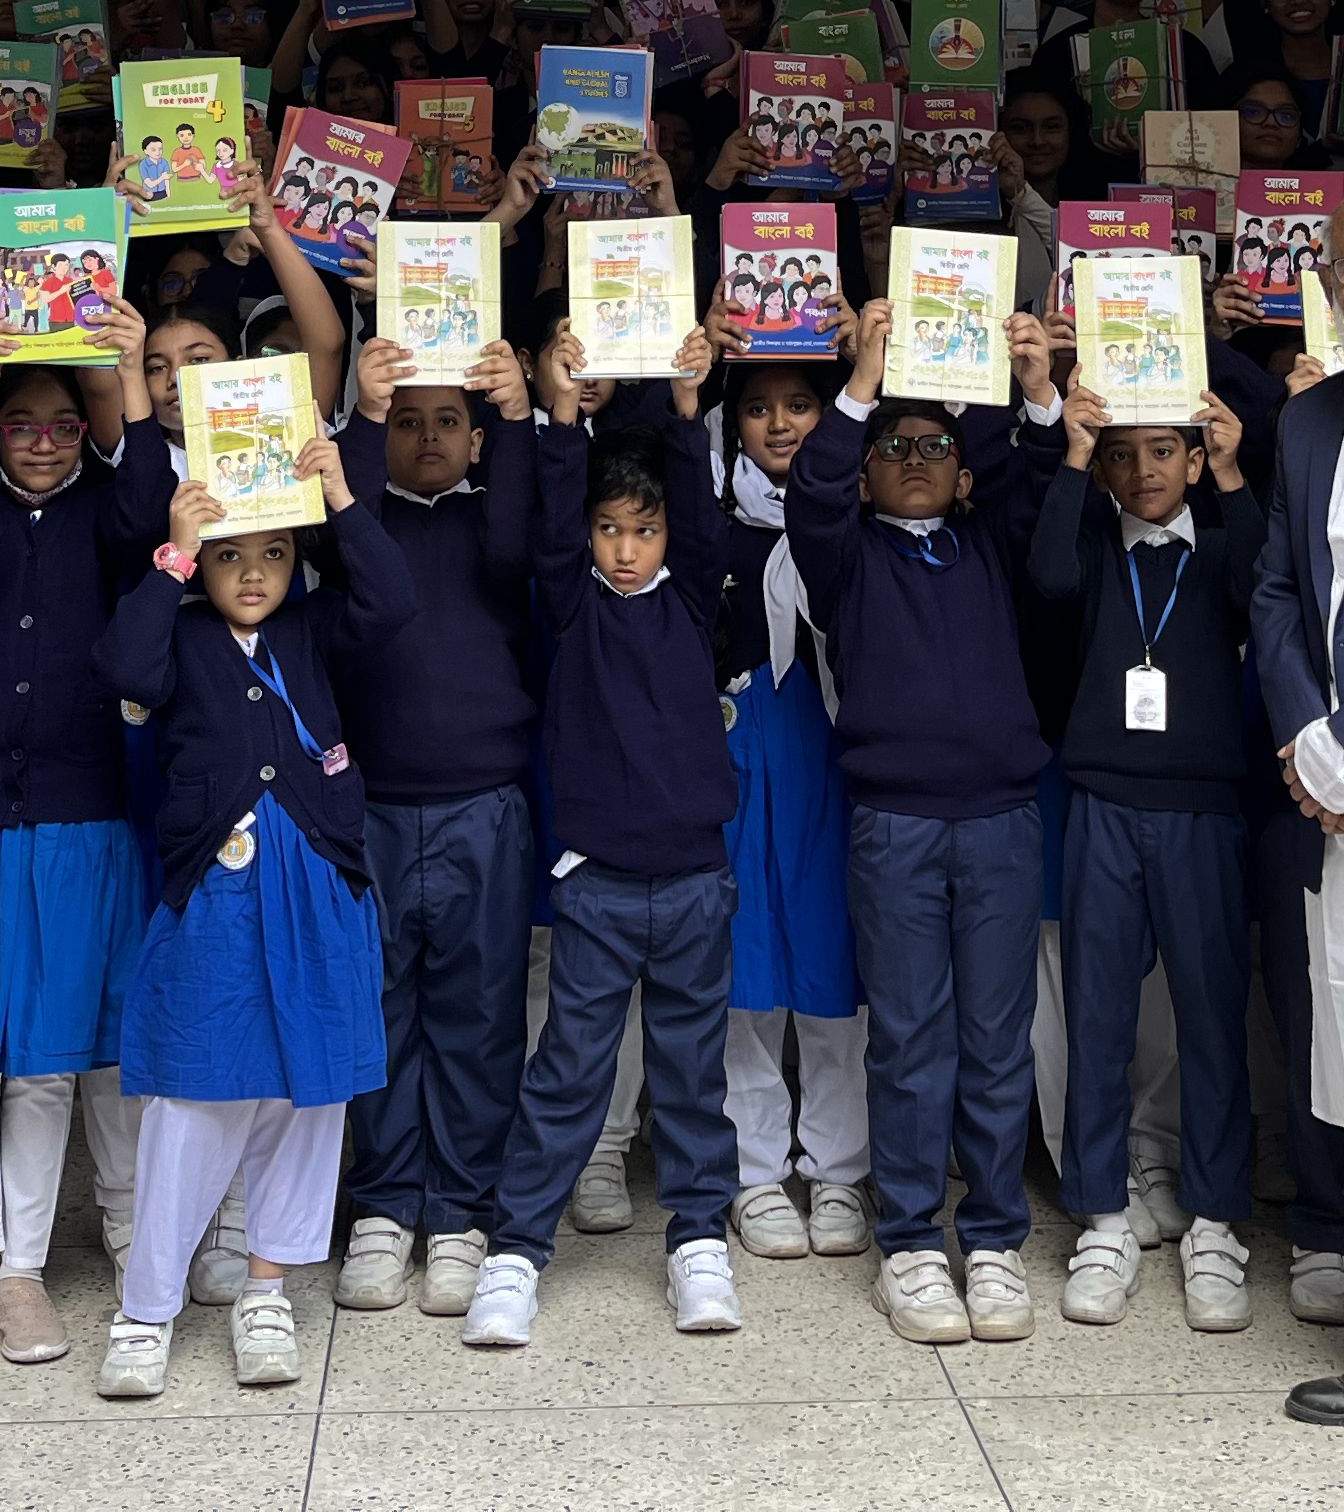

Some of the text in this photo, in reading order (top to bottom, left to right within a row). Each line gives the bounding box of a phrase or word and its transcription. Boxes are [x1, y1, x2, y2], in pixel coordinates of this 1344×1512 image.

[817, 23, 849, 37] বাংলা
[773, 60, 806, 73] আমার
[774, 73, 827, 88] বাংলা বই
[151, 81, 209, 96] ENGLISH
[177, 96, 206, 105] TODAY
[858, 96, 876, 113] বই
[207, 100, 226, 124] 4
[959, 107, 976, 121] বই
[329, 121, 365, 144] আমার
[326, 137, 385, 168] বাংলা বই
[1263, 177, 1300, 189] আমার
[1264, 189, 1325, 207] বাংলা বই
[14, 203, 57, 218] আমার
[751, 211, 789, 223] আমার
[1086, 209, 1125, 222] আমার
[15, 214, 86, 235] বাংলা বই
[753, 222, 814, 241] বাংলা বই
[1088, 222, 1150, 239] বাংলা বই
[406, 235, 472, 247] আমার বাংলা বই
[597, 234, 623, 244] আমার
[652, 230, 665, 240] বই
[921, 246, 989, 261] আমার বাংলা বই
[1103, 270, 1173, 281] আমার বাংলা বই
[211, 373, 282, 389] আমার বাংলা বই
